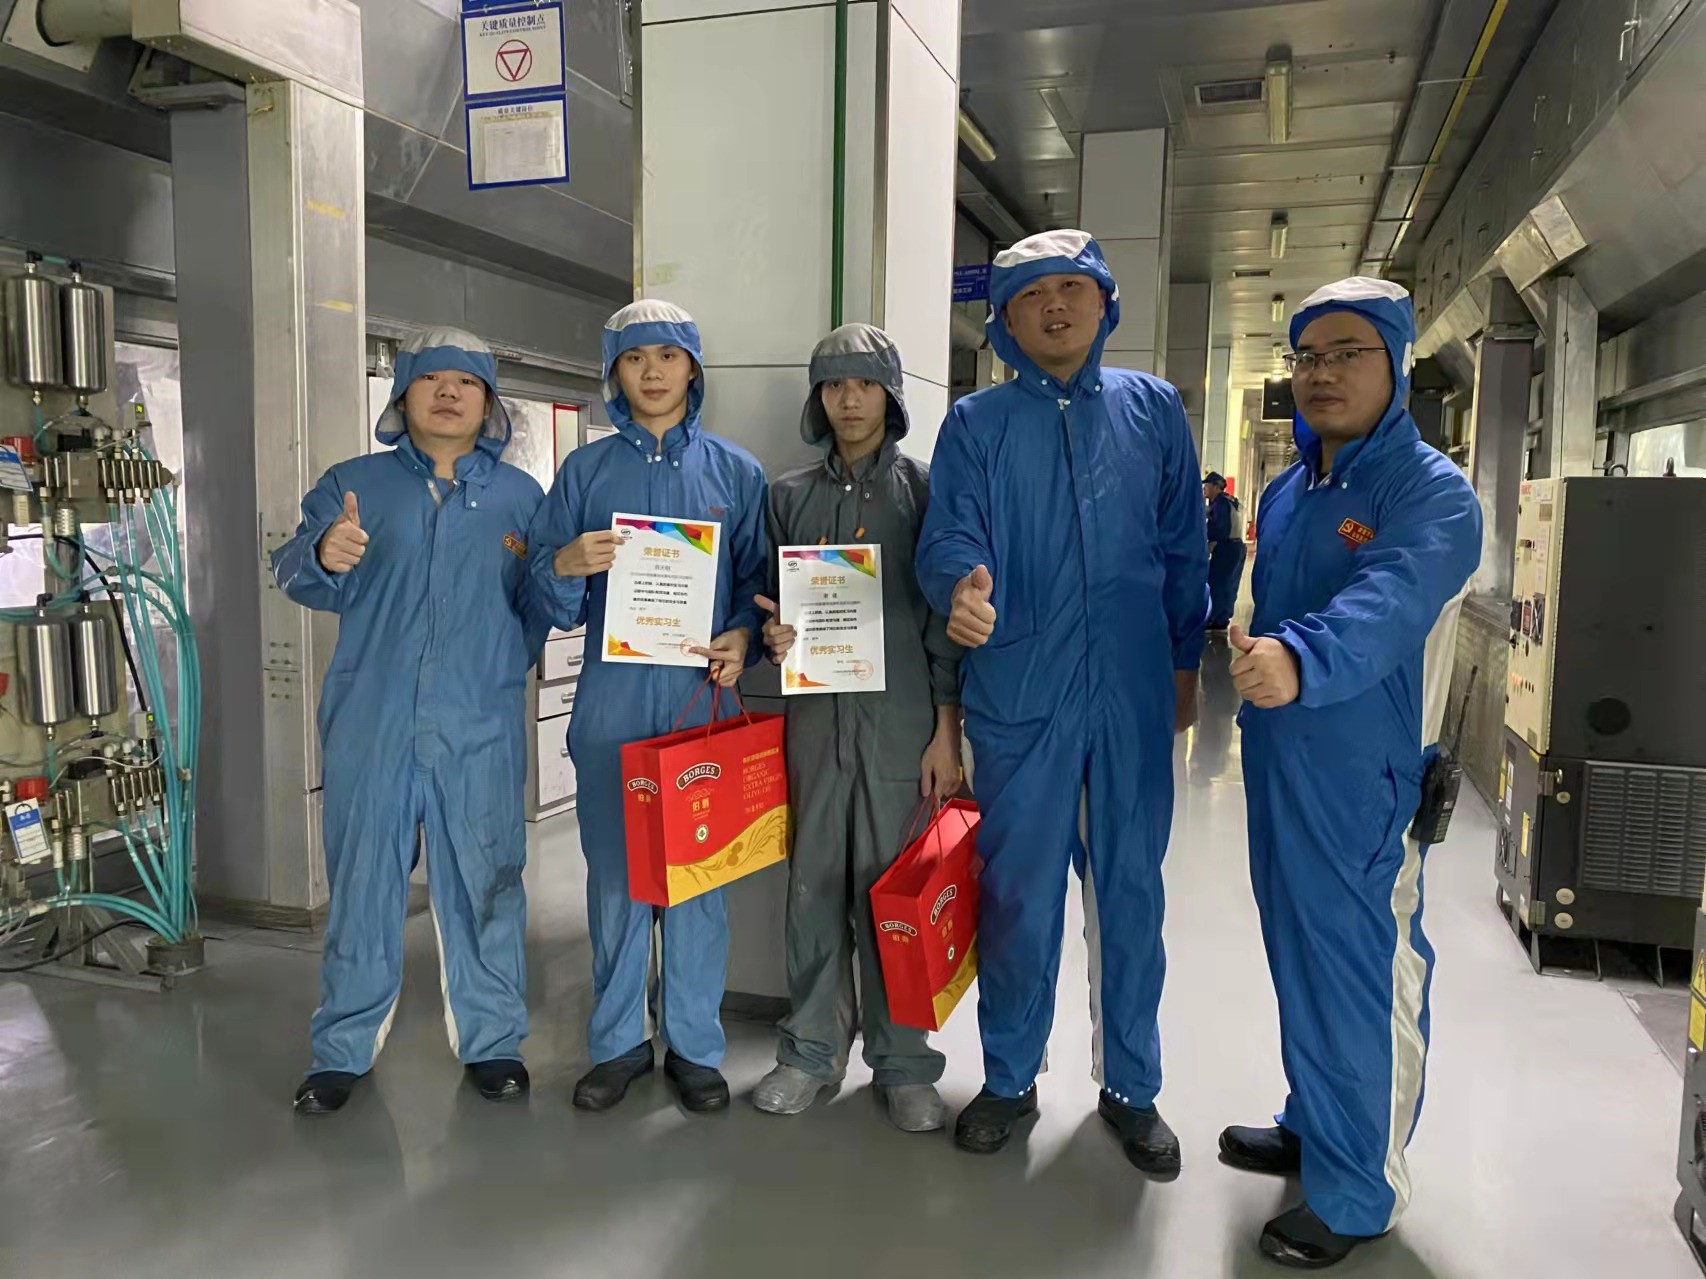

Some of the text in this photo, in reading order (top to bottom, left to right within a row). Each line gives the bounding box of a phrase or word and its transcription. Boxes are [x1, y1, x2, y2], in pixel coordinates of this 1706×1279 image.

[481, 13, 546, 31] 关键质量控制点
[636, 615, 681, 627] 优秀实习生
[810, 644, 854, 655] 优秀实习生
[682, 765, 716, 783] BORGES
[631, 778, 655, 791] BORGES
[933, 887, 954, 917] BORGES
[884, 922, 912, 933] BORGES
